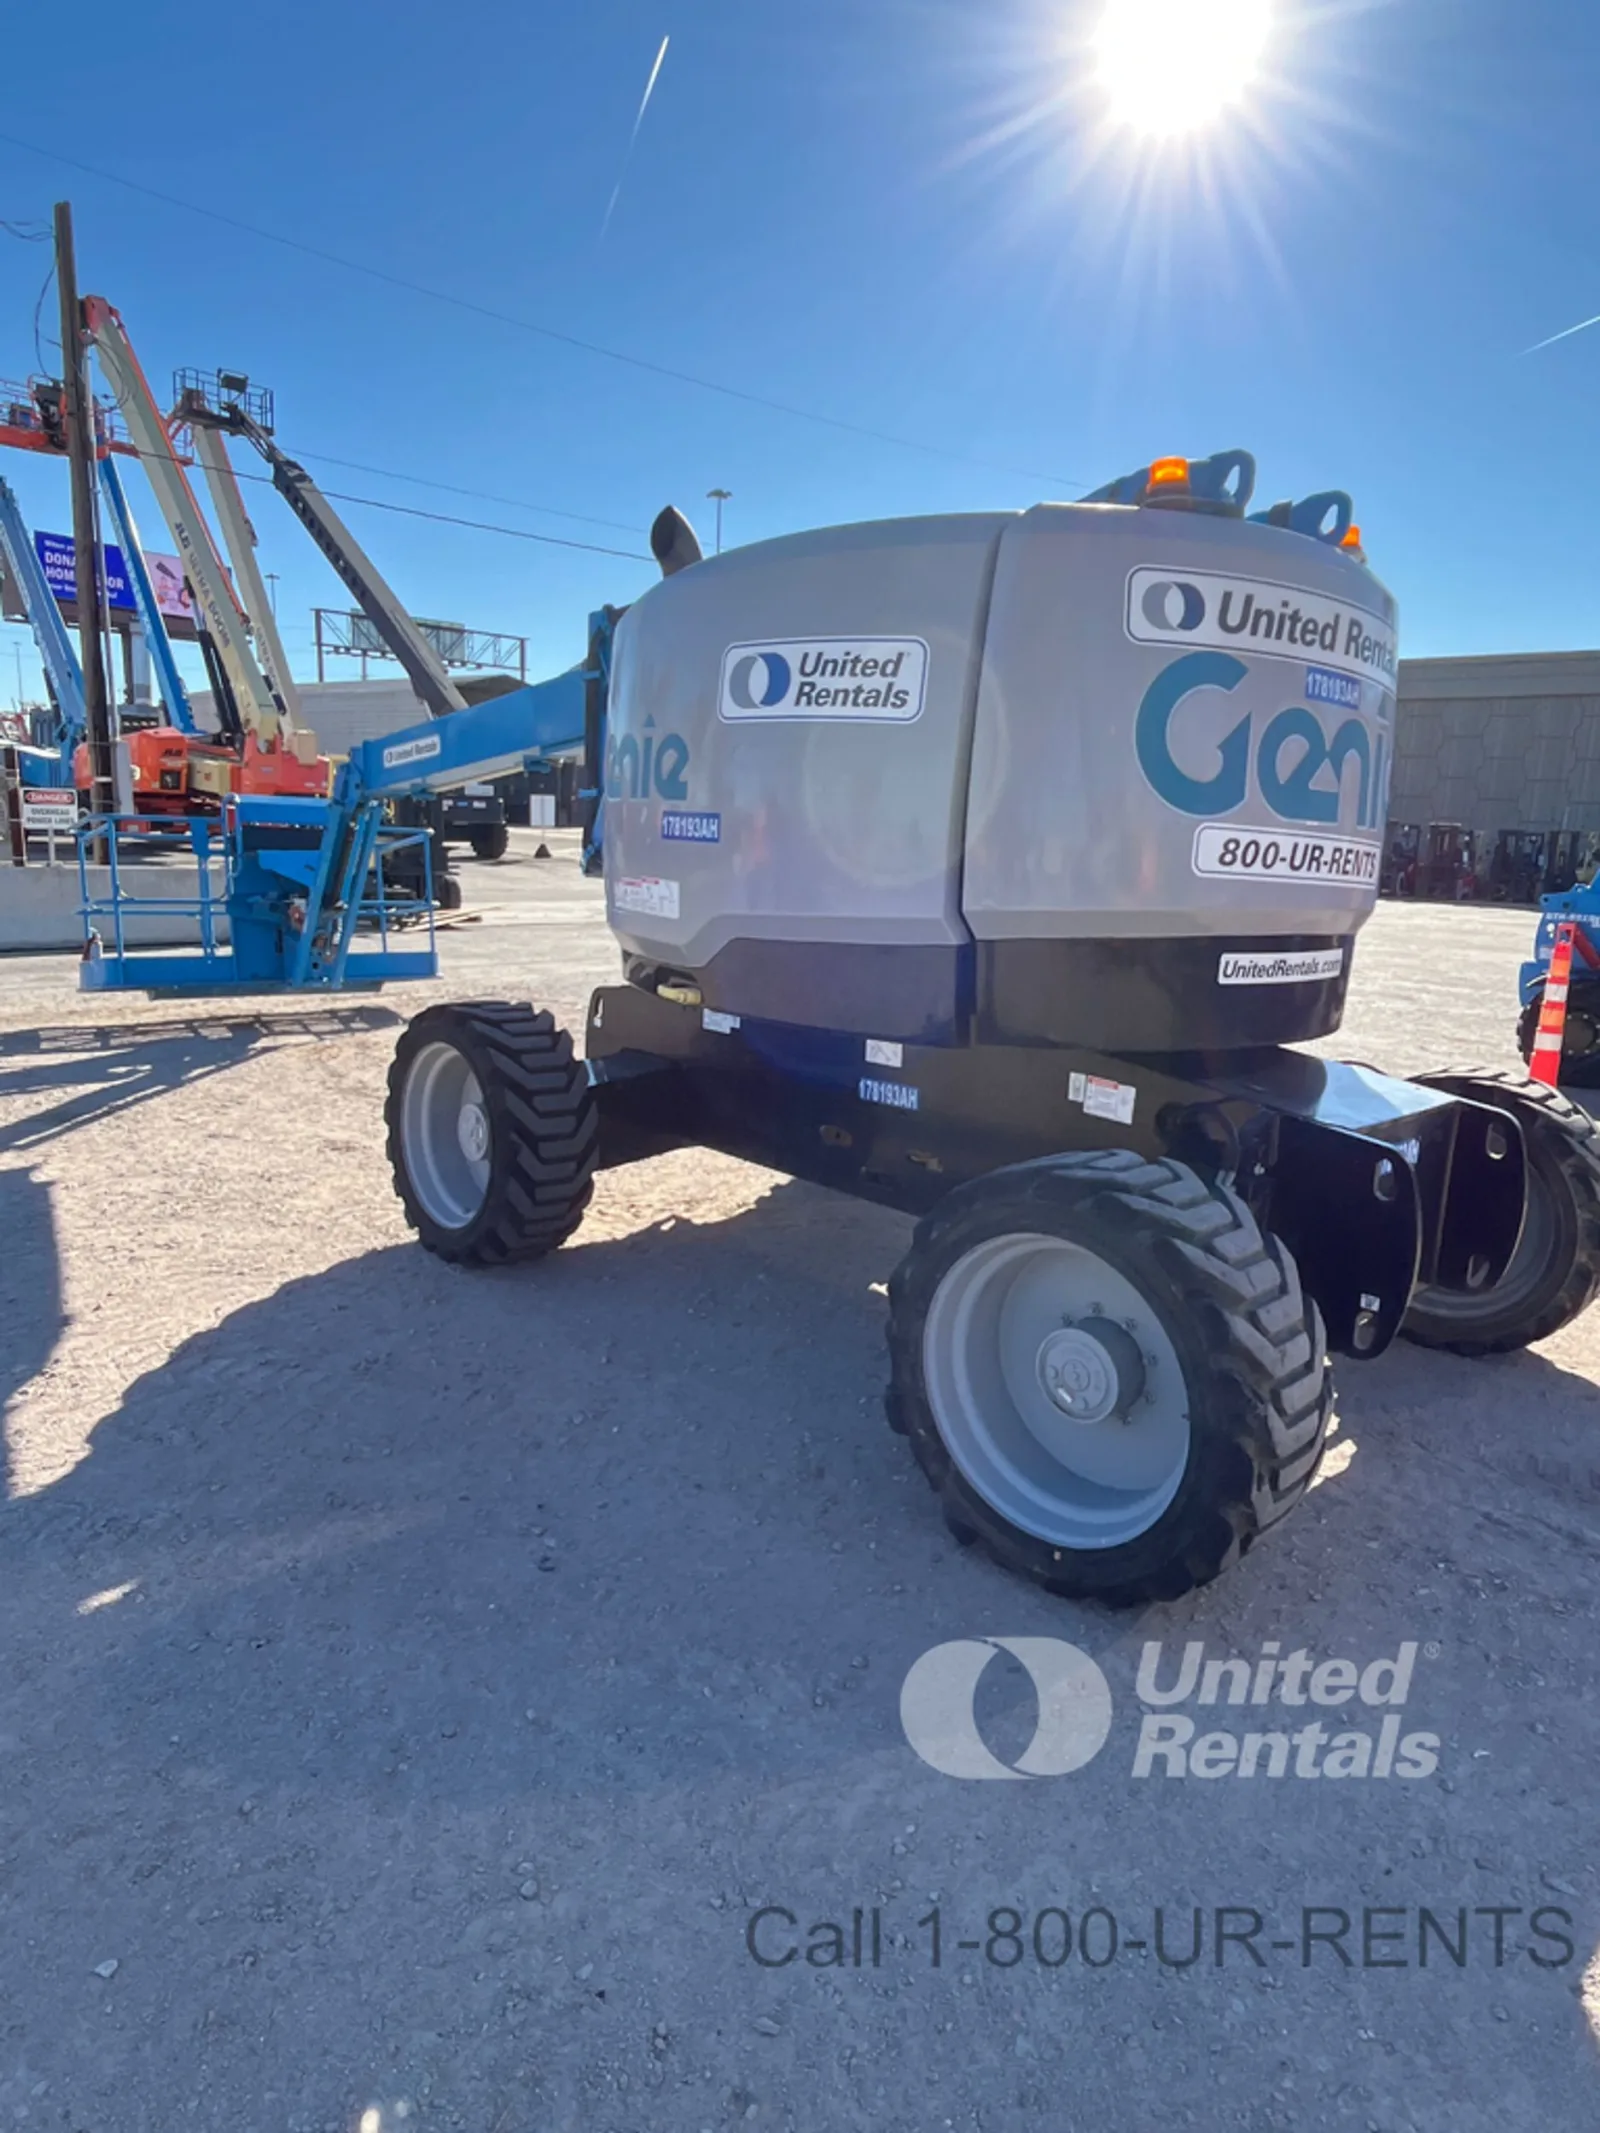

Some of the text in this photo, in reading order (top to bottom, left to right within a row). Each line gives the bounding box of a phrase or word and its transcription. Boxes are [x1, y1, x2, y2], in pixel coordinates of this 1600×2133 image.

[46, 566, 75, 581] HOM
[1218, 590, 1395, 672] United Renta
[798, 651, 904, 678] United
[794, 681, 910, 709] Rentals
[1135, 650, 1390, 830] Geni
[662, 815, 719, 840] 178193AH
[1218, 838, 1376, 879] 800-UR-RENTS
[1222, 957, 1342, 979] UnitedRentals.com
[860, 1078, 919, 1110] 178193AH
